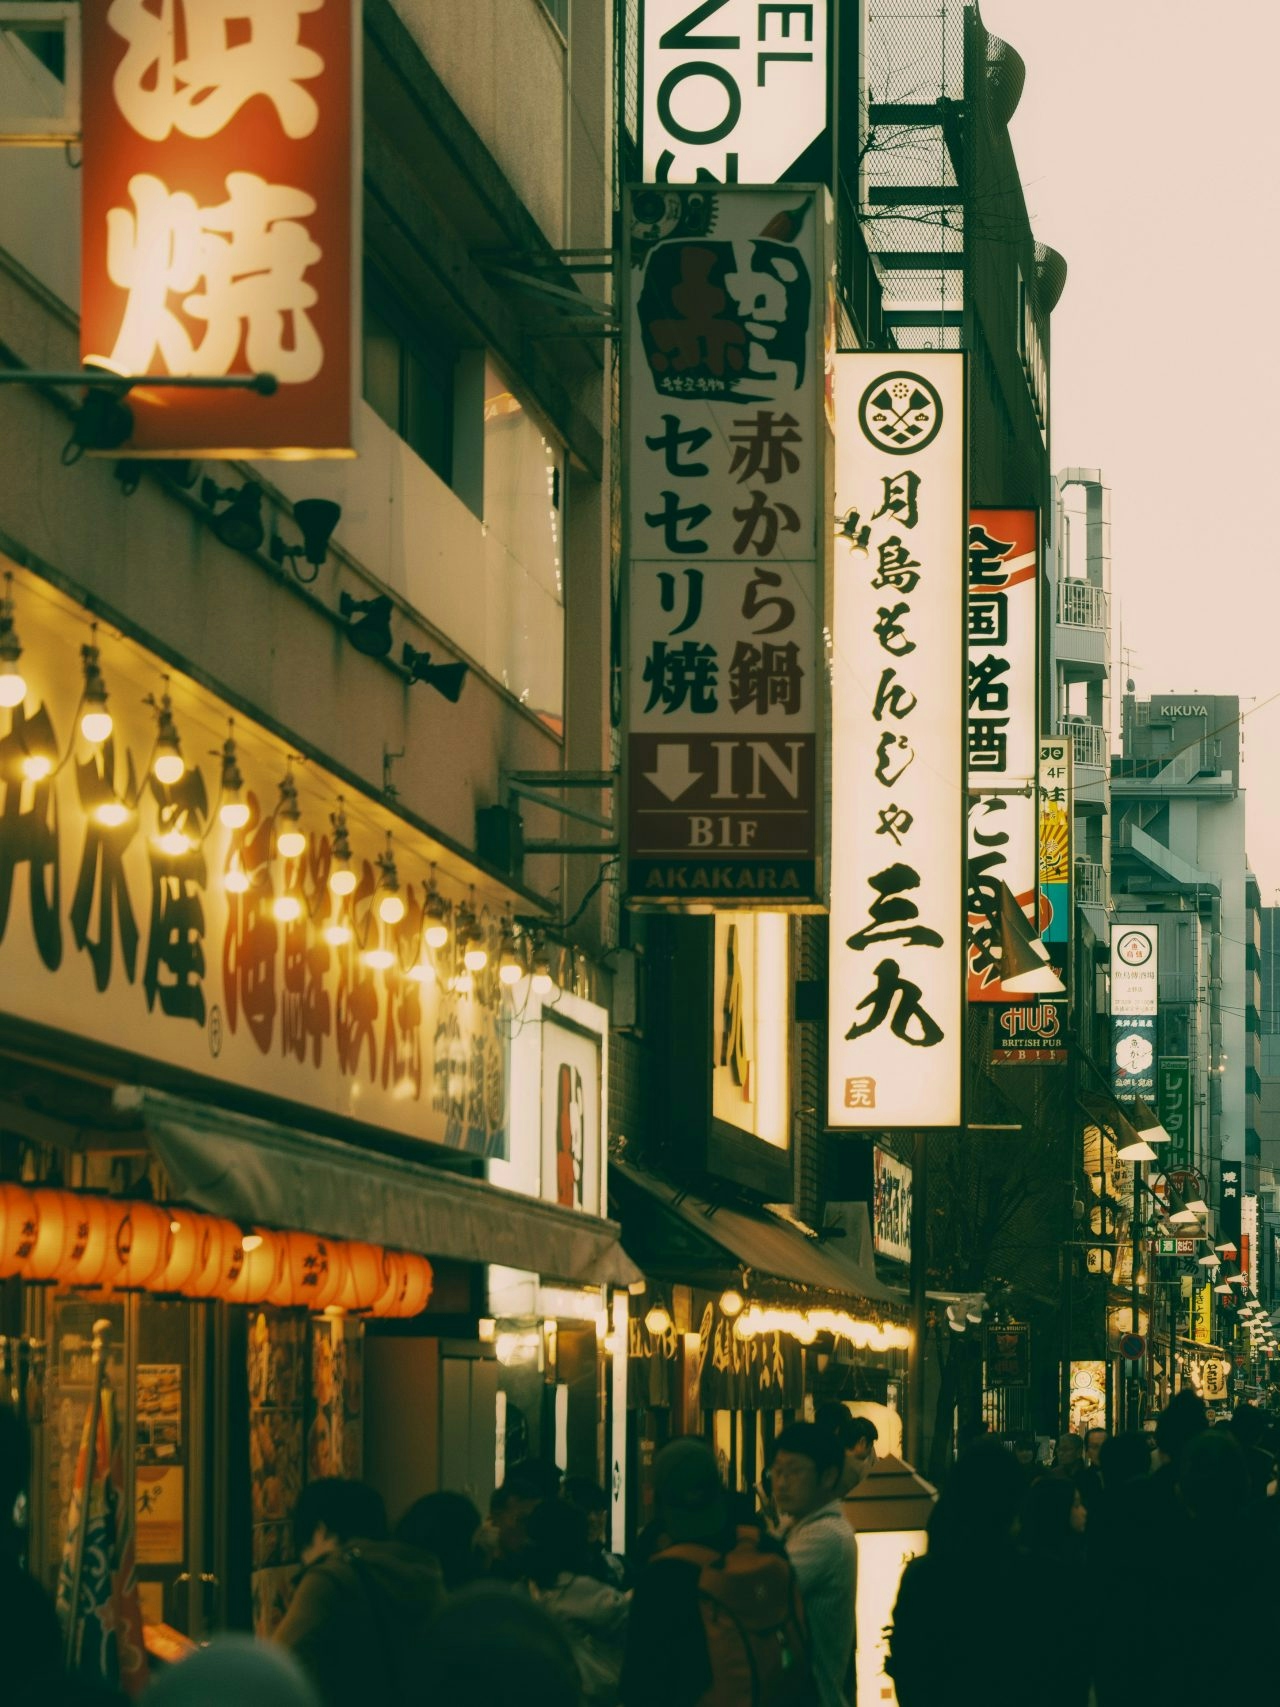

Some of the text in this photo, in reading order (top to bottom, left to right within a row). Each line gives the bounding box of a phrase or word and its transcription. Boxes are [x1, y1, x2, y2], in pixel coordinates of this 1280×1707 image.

[642, 414, 719, 716] セセリ焼
[728, 410, 804, 717] 赤から鍋
[1160, 705, 1208, 716] KIKUYA
[711, 741, 798, 801] IN
[1047, 768, 1066, 779] 4F
[688, 815, 757, 848] B1F
[645, 864, 800, 891] AKAKARA
[1000, 1004, 1060, 1038] HUB
[1002, 1039, 1061, 1047] BRITISH PUB
